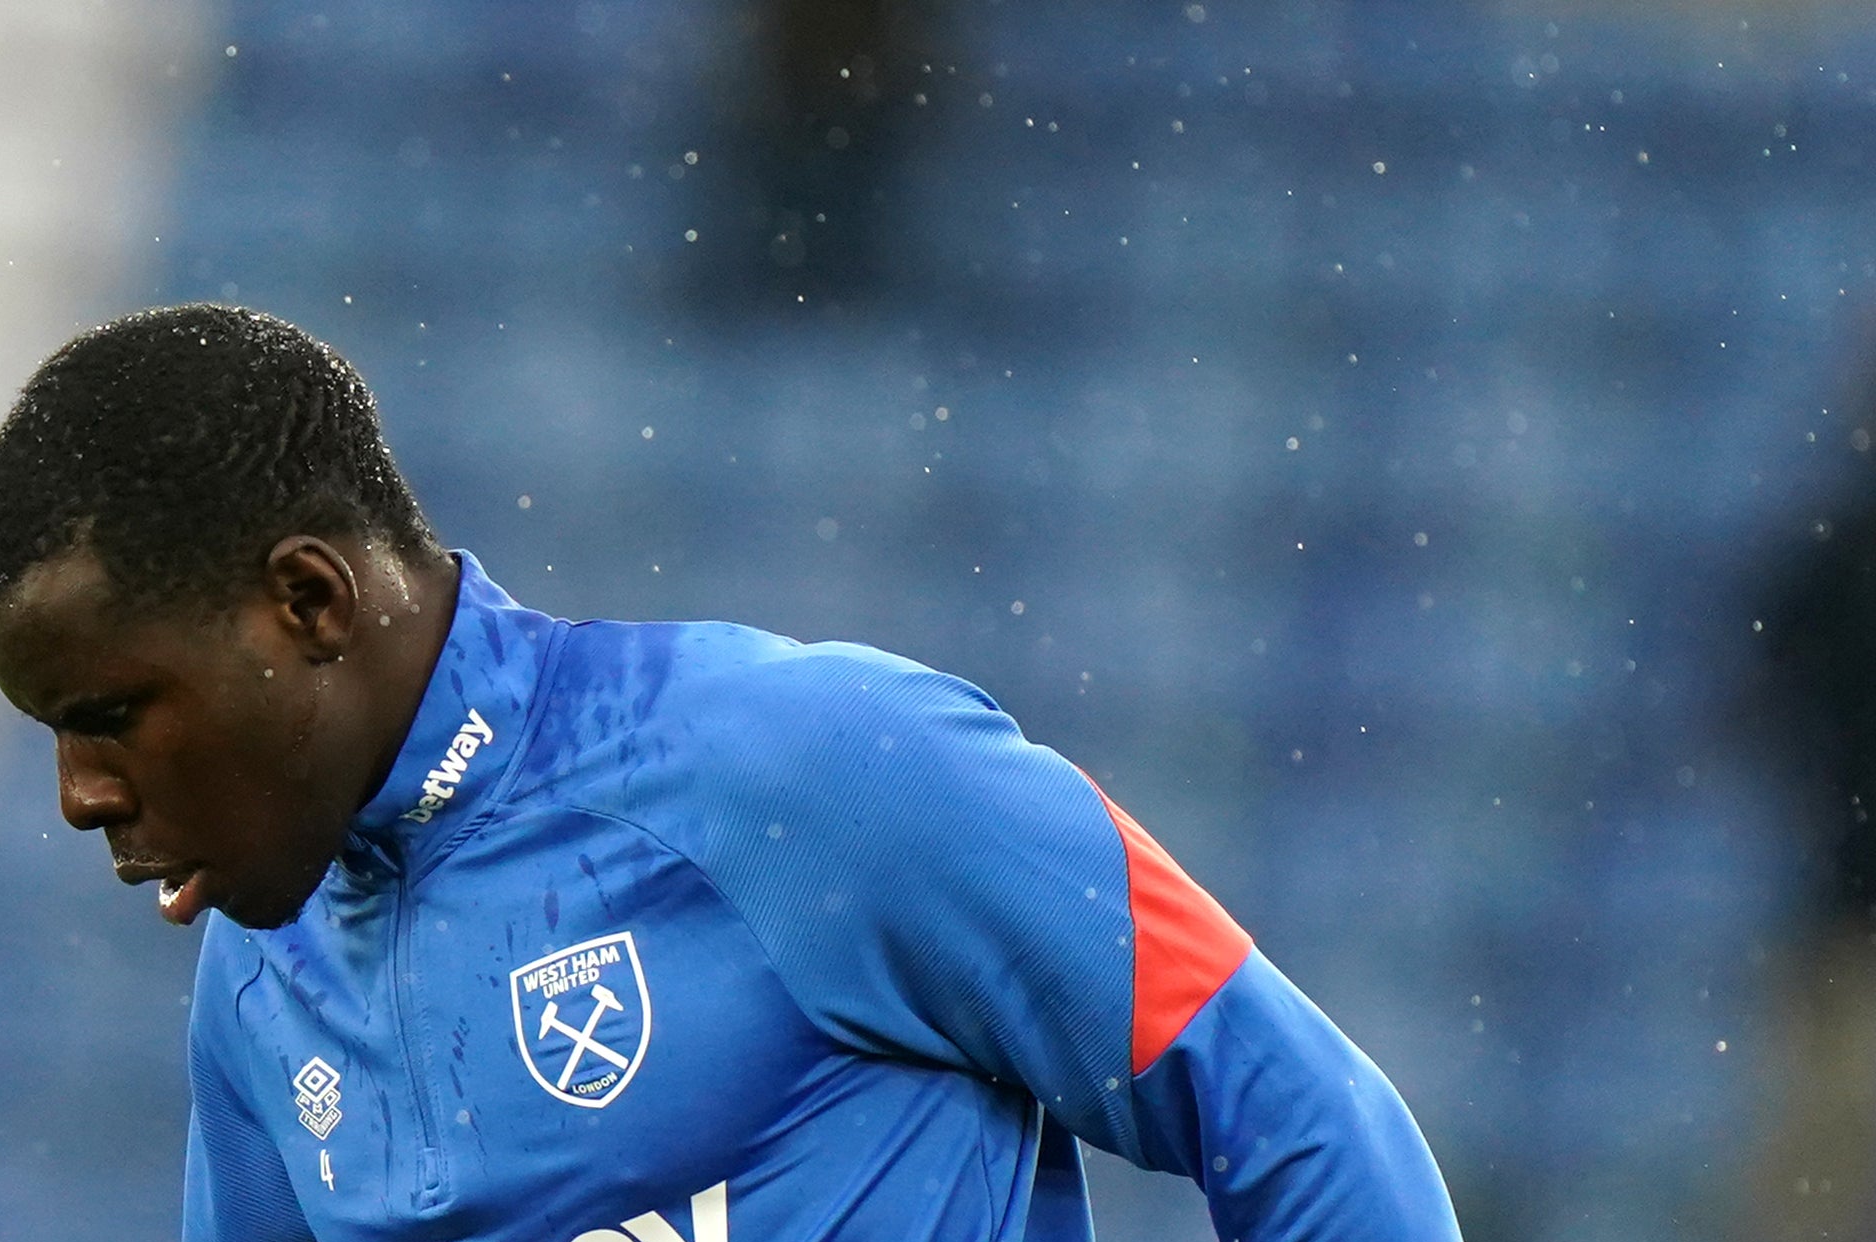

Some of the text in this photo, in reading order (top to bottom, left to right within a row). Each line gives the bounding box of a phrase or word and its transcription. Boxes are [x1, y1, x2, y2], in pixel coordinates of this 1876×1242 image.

[398, 707, 494, 824] betway
[523, 945, 620, 993] WEST HAM
[542, 967, 600, 999] UNITED
[571, 1071, 618, 1095] LONDON
[320, 1149, 334, 1192] 4
